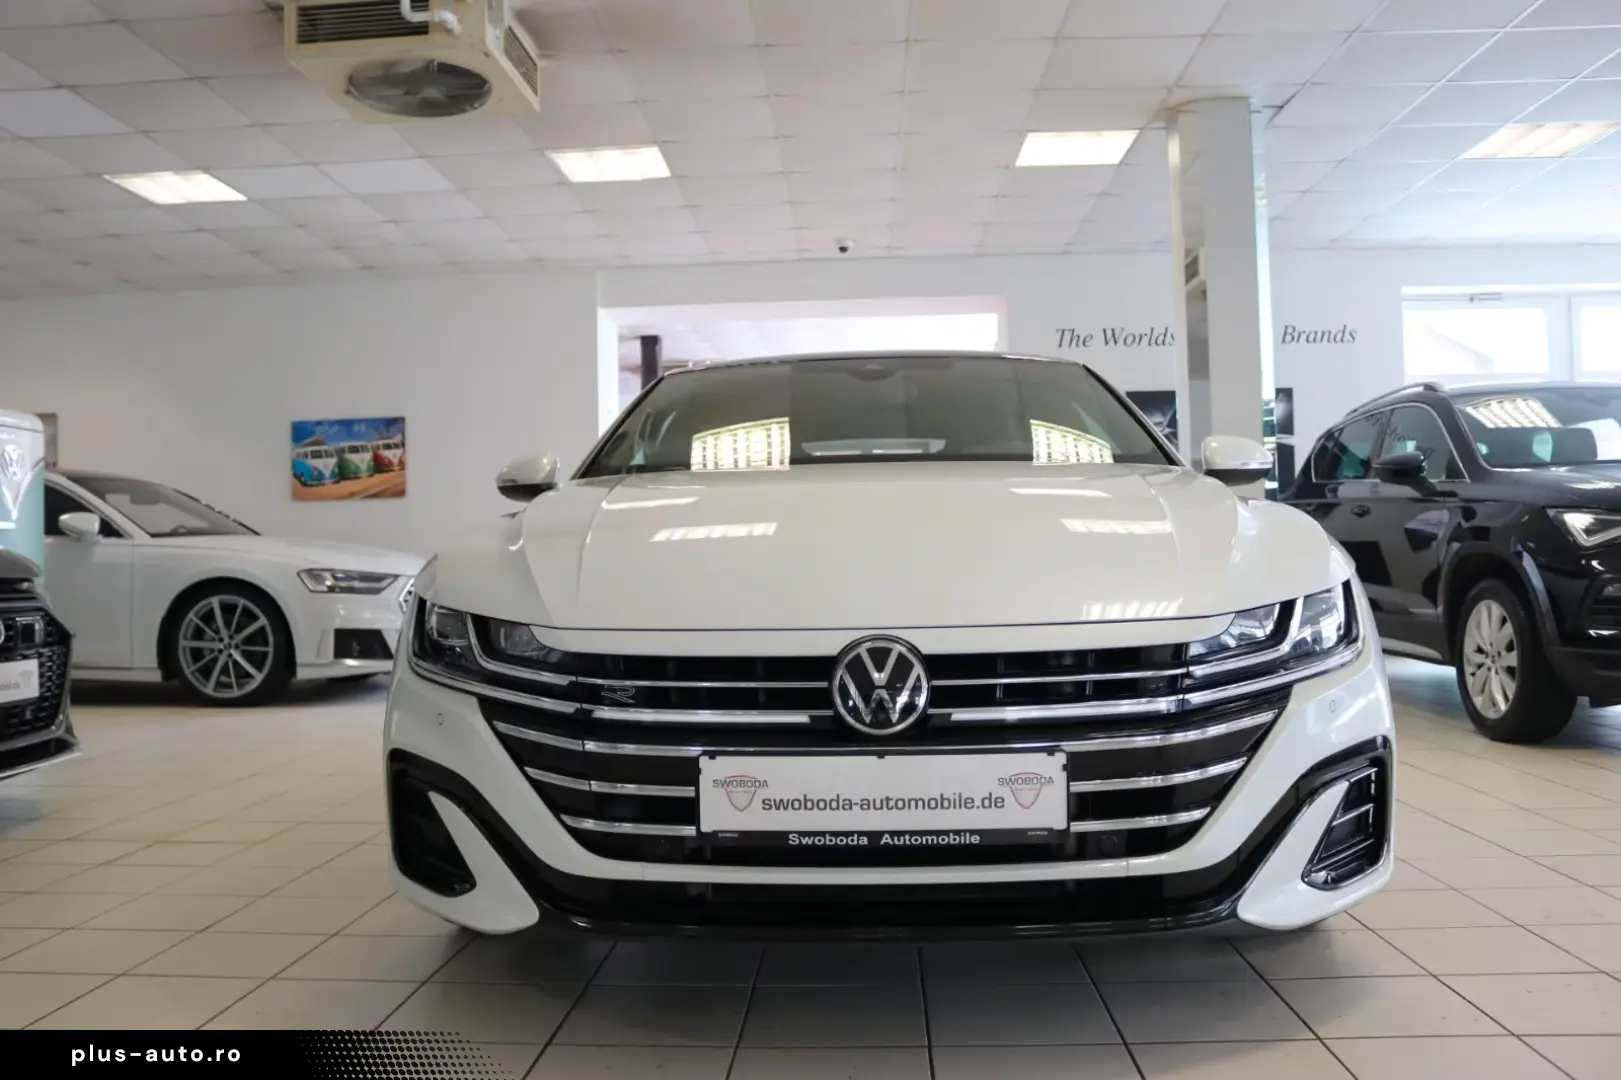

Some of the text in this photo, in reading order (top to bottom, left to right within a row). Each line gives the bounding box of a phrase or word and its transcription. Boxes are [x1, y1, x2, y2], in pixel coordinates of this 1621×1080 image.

[1055, 327, 1094, 348] The
[1280, 324, 1358, 345] Brands
[837, 643, 927, 728] VW
[712, 779, 769, 788] SWOBODA
[997, 776, 1055, 786] SWOBODA
[761, 793, 1005, 812] swoboda-automobile.de
[788, 832, 981, 846] Swoboda Automobile
